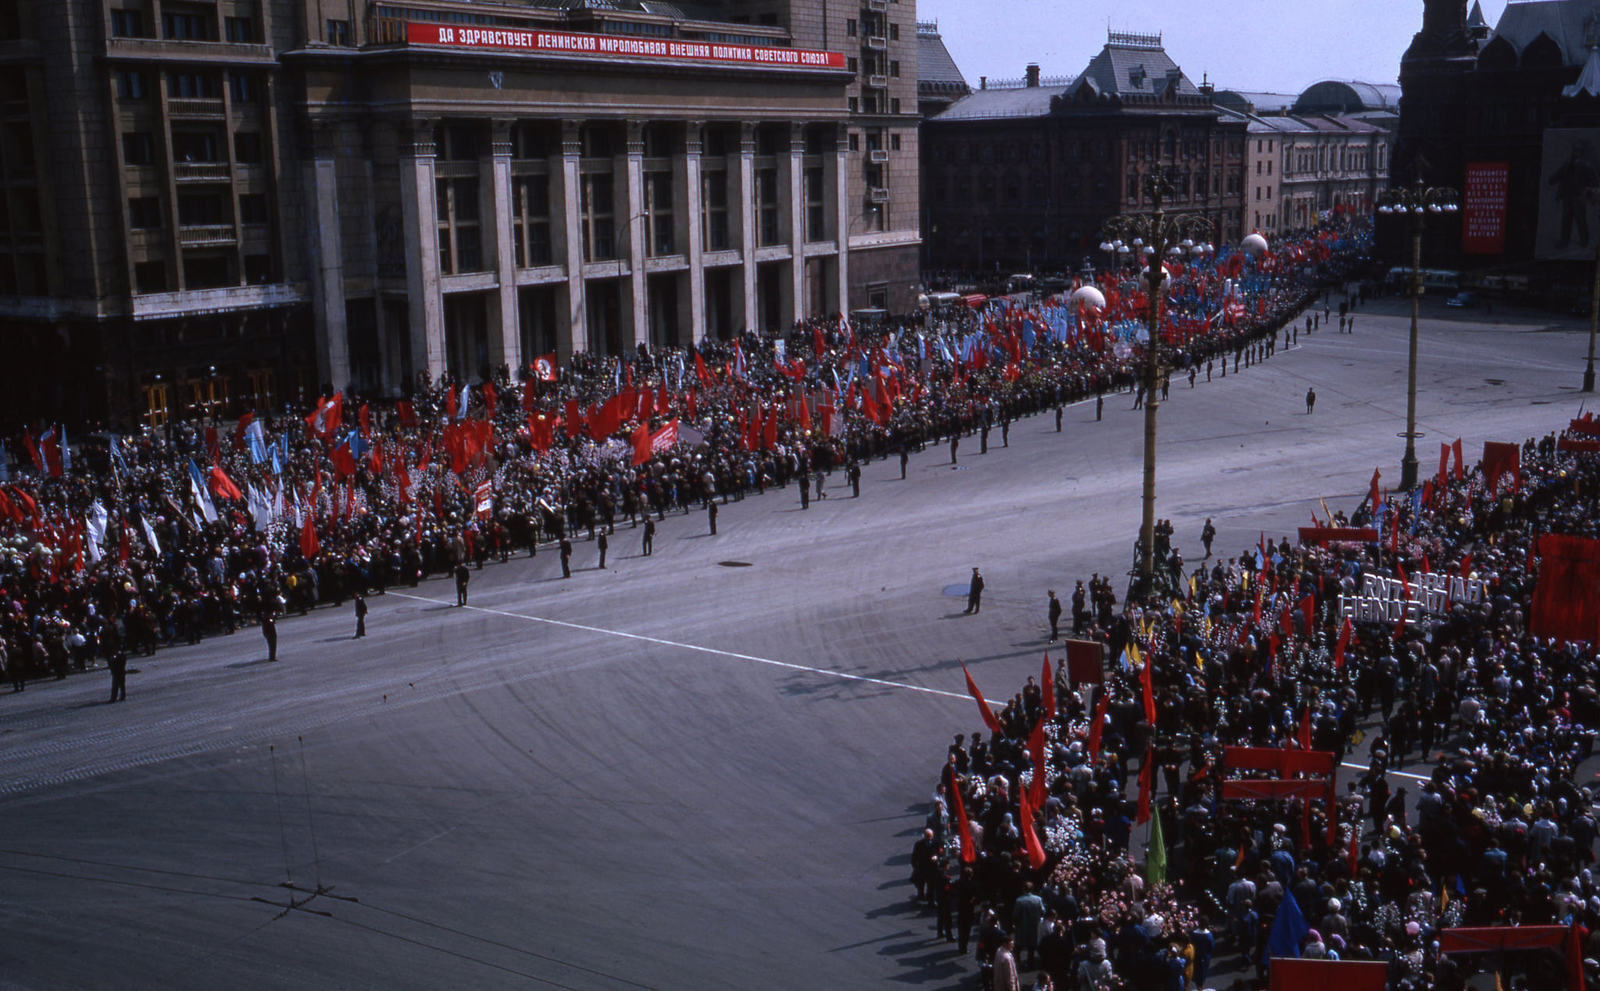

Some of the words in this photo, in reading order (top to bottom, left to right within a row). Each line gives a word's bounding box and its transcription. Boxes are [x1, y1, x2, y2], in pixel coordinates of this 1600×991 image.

[439, 27, 454, 43] ДА
[459, 29, 533, 47] ЗДРАВСТВУЕТ
[538, 34, 596, 50] ЛЕНИНСКАЯ
[600, 38, 666, 55] МИРОЛЮБИВАЯ
[670, 43, 710, 57] ВНЕШНЯЯ
[713, 47, 751, 60] ПОЛИТИКА
[755, 50, 798, 63] СОВЕТСКОГО
[801, 53, 829, 64] СОЮЗА!
